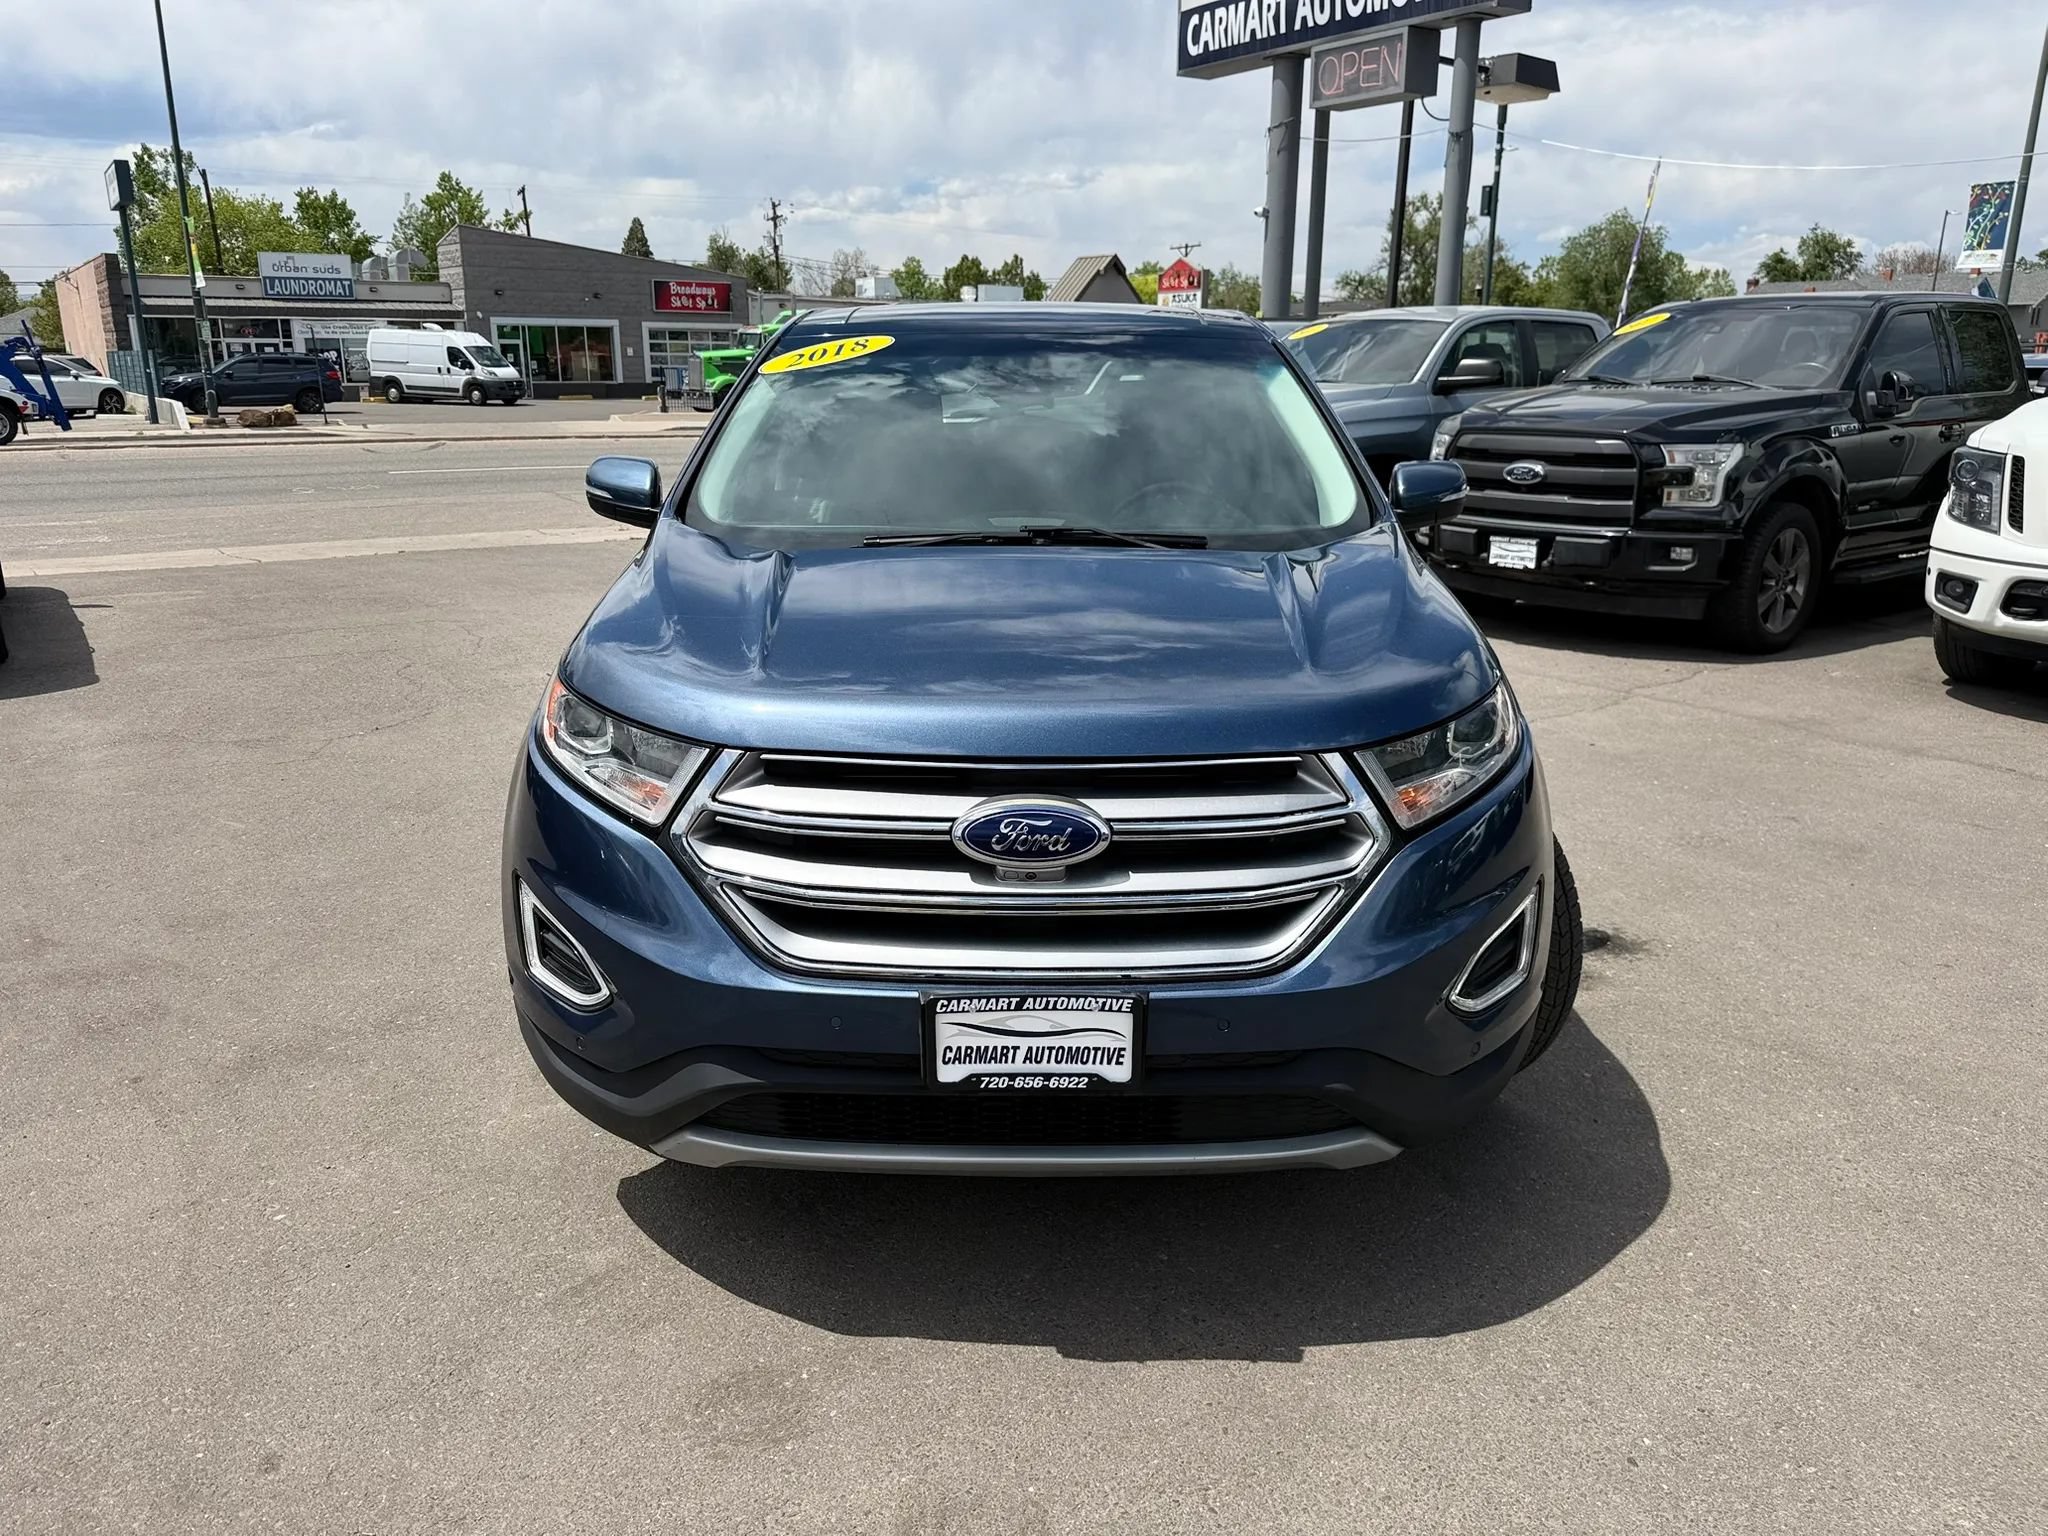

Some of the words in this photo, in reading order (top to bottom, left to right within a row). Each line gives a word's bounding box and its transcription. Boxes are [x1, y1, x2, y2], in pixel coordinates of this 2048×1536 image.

[1186, 0, 1289, 57] CARMART
[1318, 42, 1403, 96] OPEN
[271, 258, 308, 273] urban
[312, 265, 342, 275] suds
[265, 279, 351, 297] LAUNDROMAT
[785, 338, 869, 369] 2018
[991, 817, 1073, 852] Ford
[936, 998, 1019, 1013] CARMART
[1022, 997, 1134, 1012] AUTOMOTIVE
[941, 1045, 1020, 1066] CARMART
[1022, 1046, 1127, 1066] AUTOMOTIVE
[979, 1076, 1089, 1089] 720-656-6922
